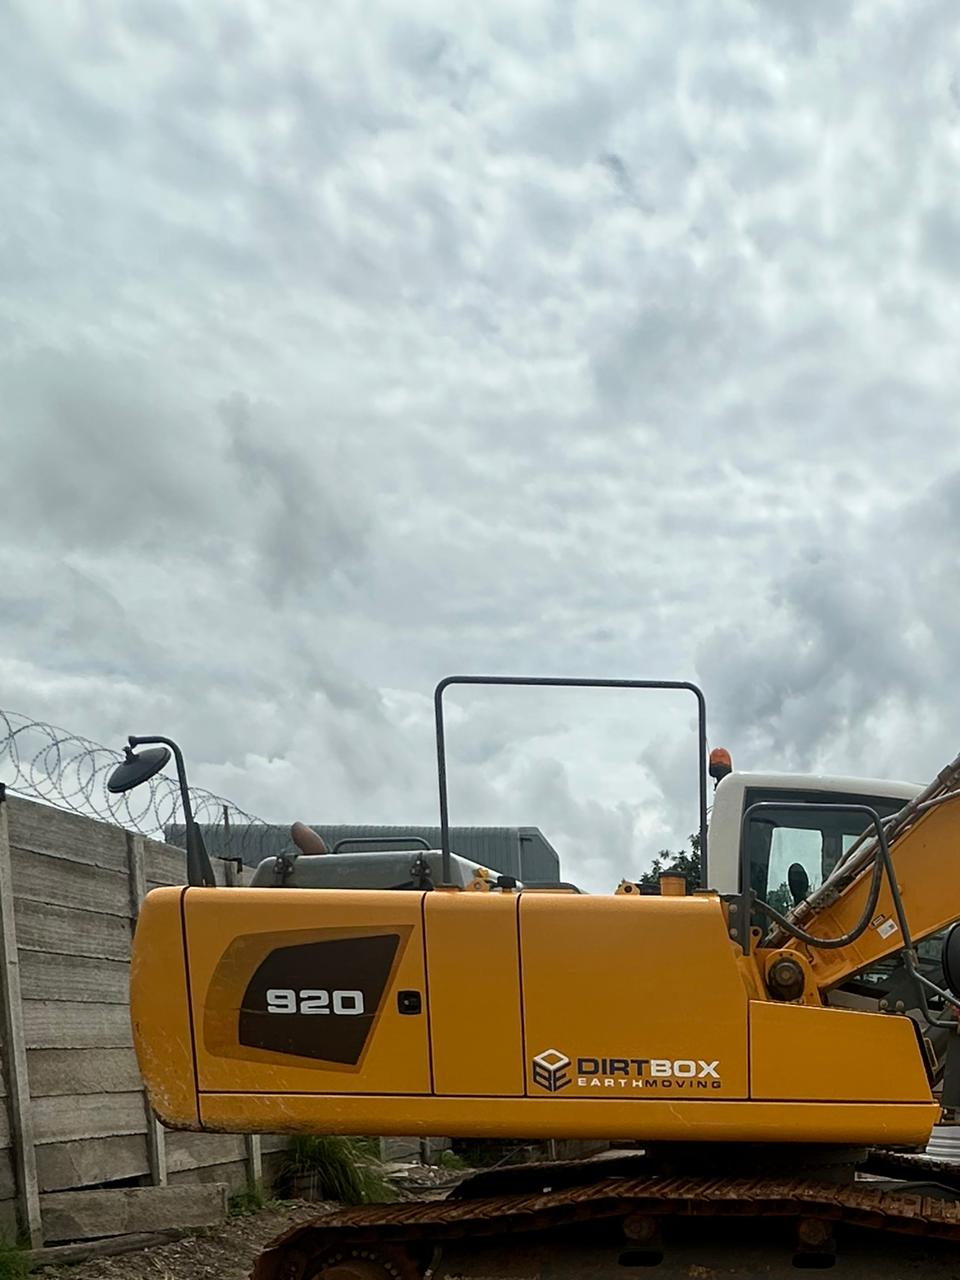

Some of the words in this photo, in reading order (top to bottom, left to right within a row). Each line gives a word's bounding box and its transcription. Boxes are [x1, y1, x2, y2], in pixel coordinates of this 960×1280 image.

[266, 989, 364, 1015] 920
[577, 1058, 721, 1078] DIRTBOX
[577, 1077, 722, 1089] EARTHMOVING
